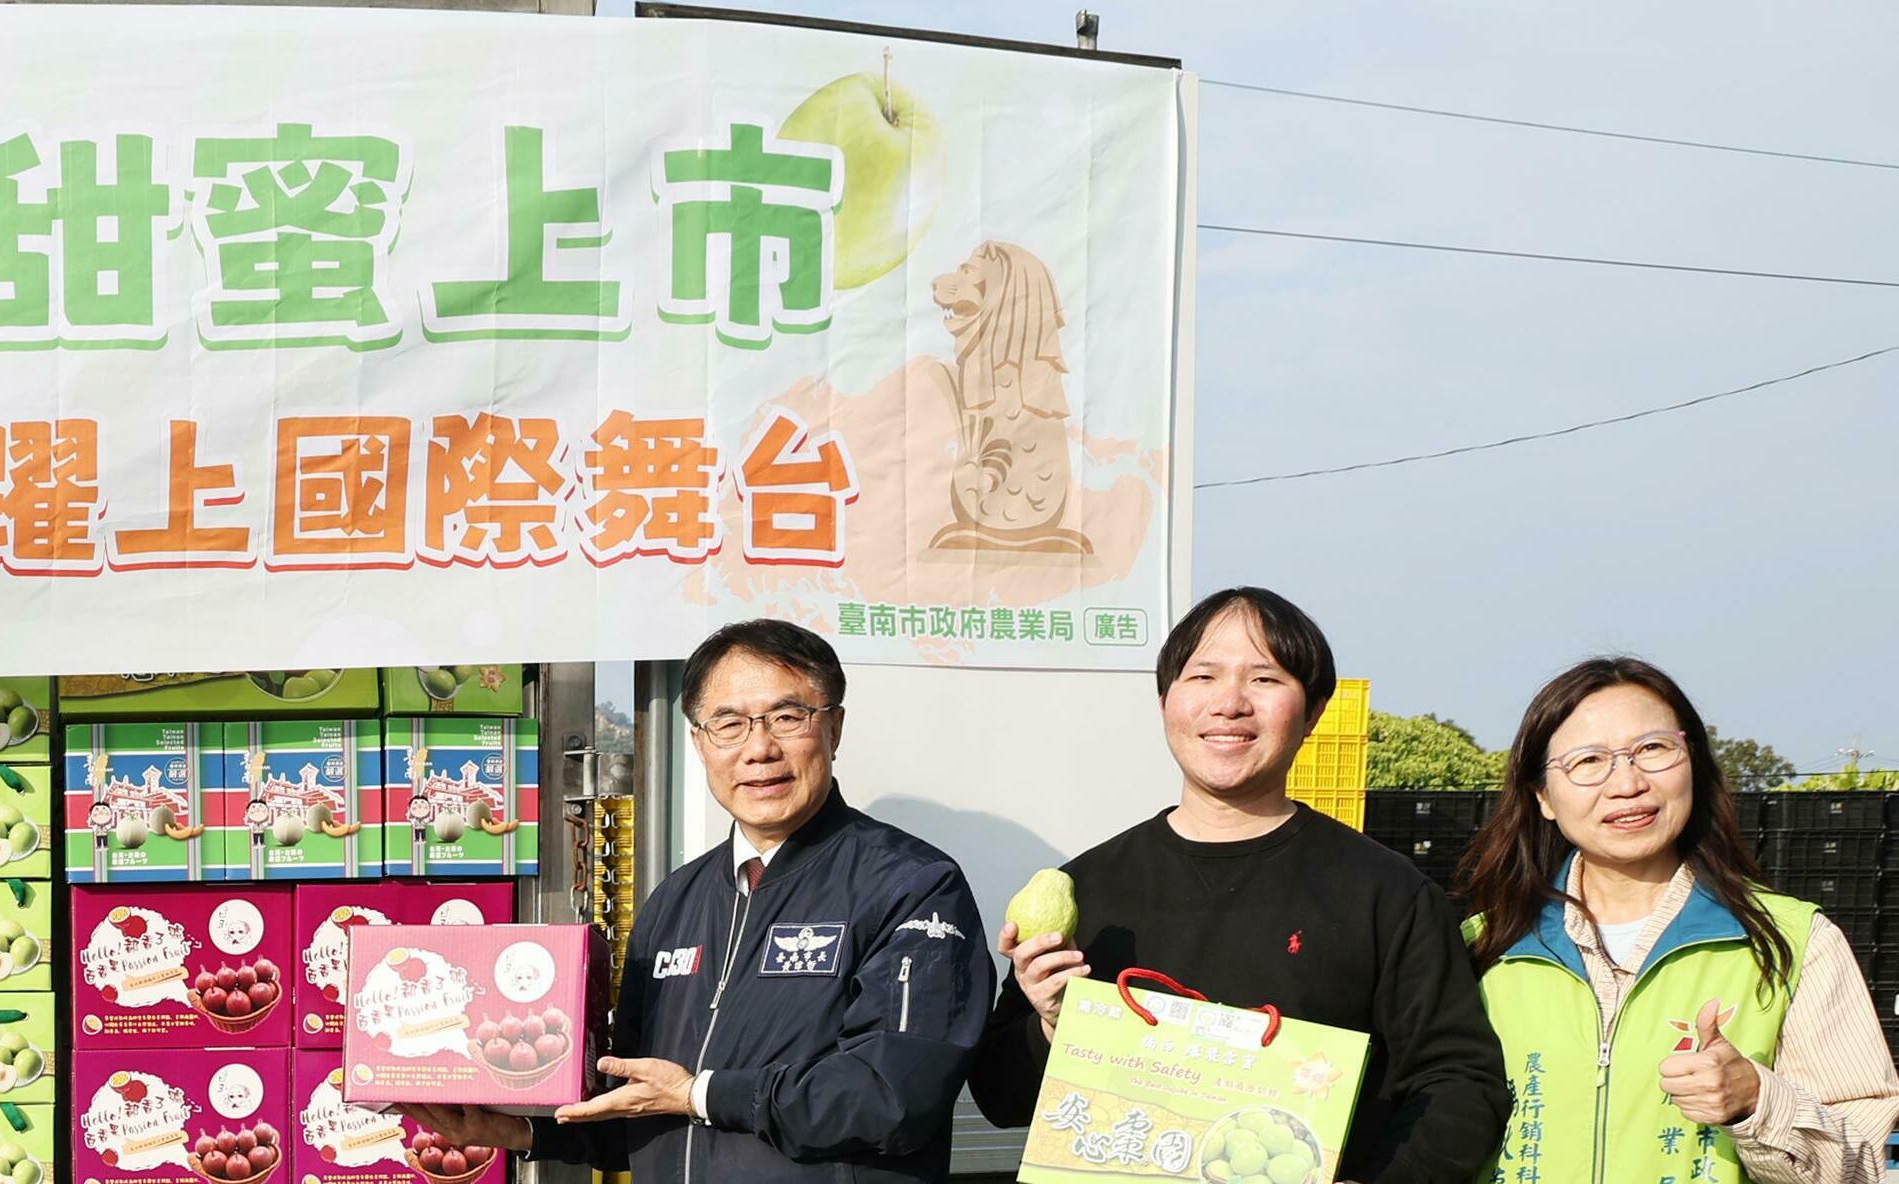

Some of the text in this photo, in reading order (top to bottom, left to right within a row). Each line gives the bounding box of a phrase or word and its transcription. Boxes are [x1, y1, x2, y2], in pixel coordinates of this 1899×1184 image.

[838, 602, 1138, 641] 臺南市政府農業局 廣告
[1063, 1043, 1202, 1085] Tasty with Safety
